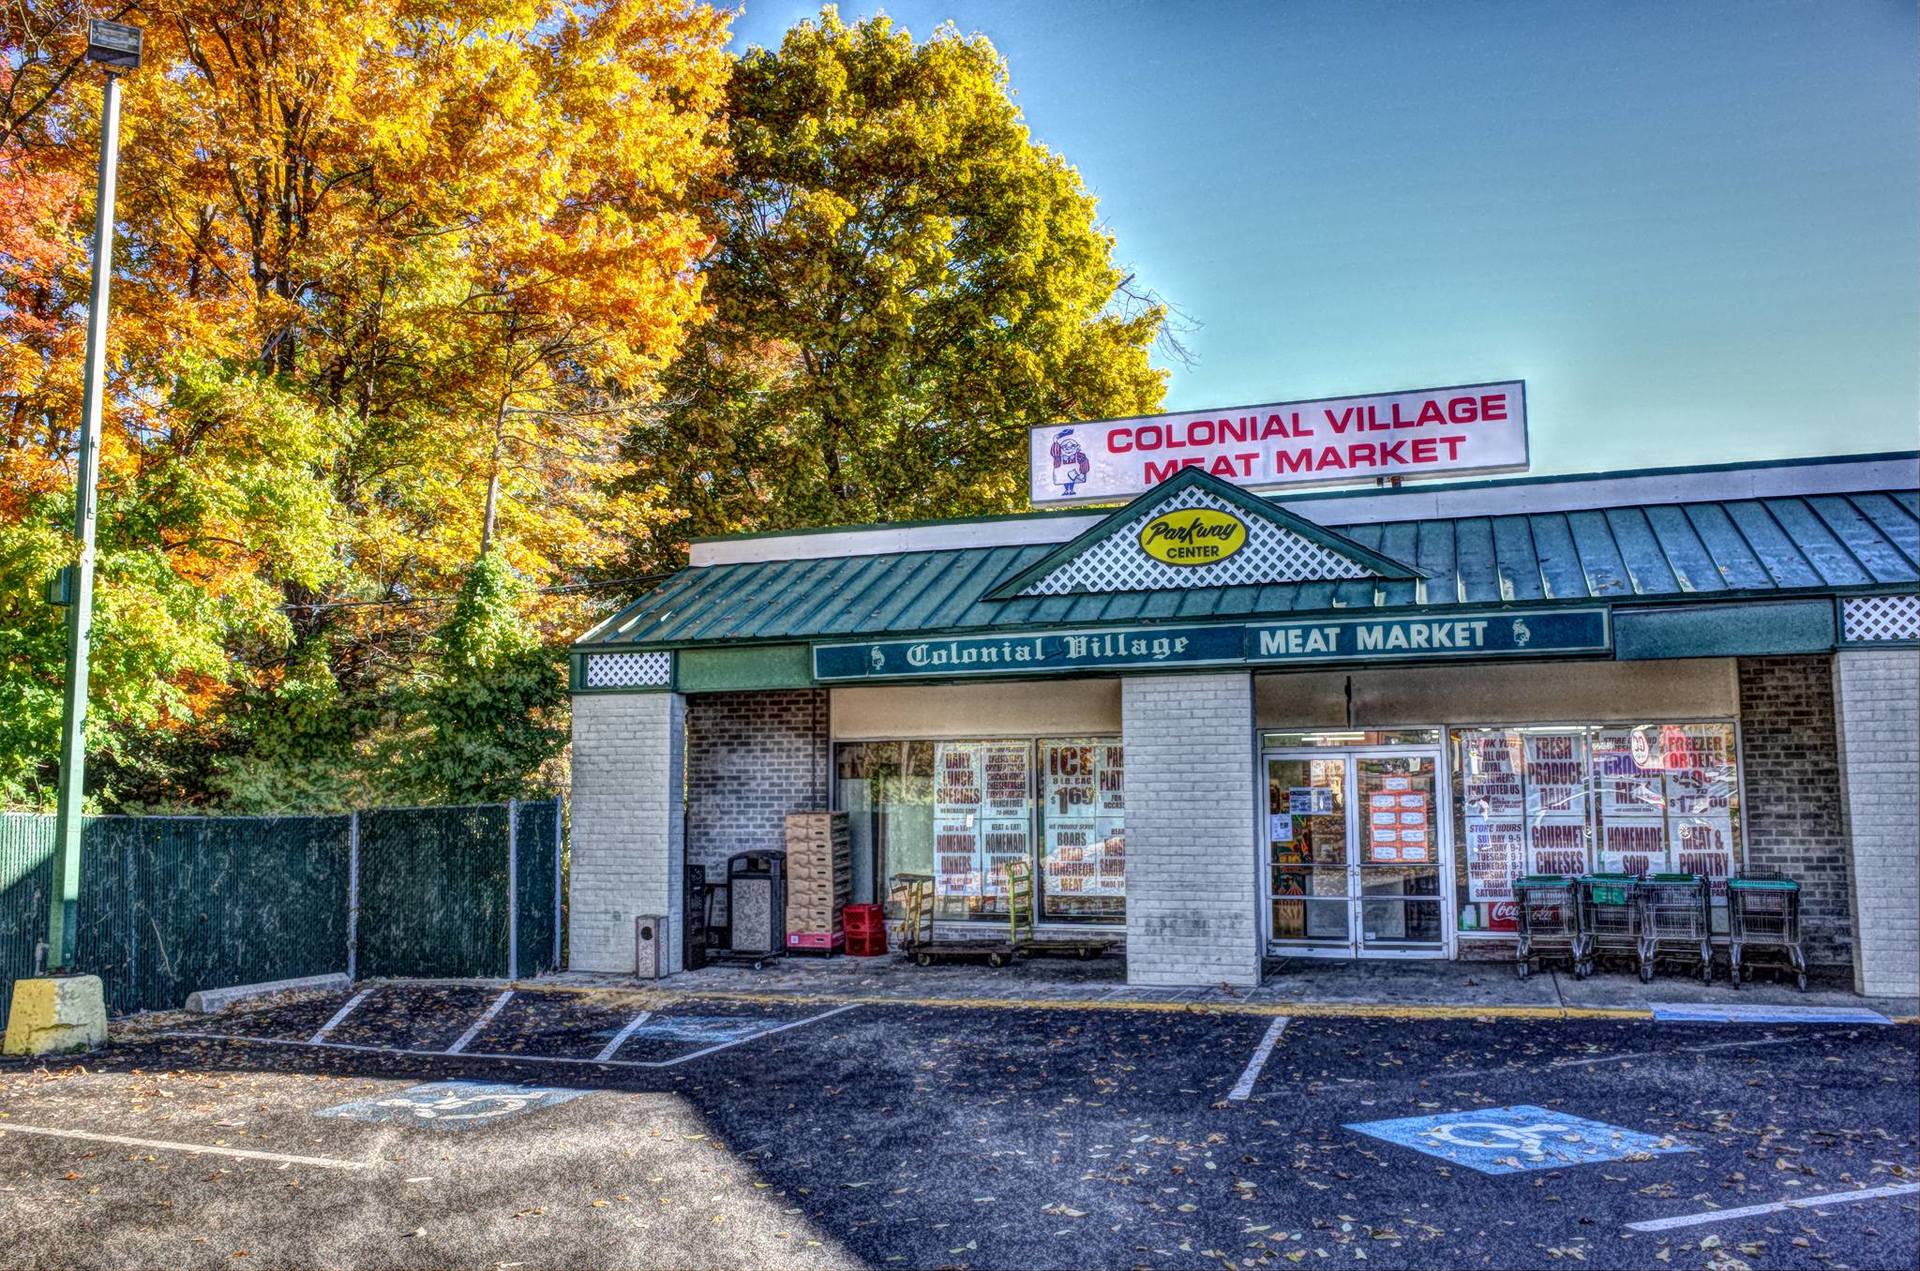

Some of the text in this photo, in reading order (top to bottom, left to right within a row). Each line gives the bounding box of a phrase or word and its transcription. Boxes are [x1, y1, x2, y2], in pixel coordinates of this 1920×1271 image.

[1107, 393, 1508, 454] COLONIAL VILLAGE
[1276, 435, 1467, 474] MARKET
[1145, 517, 1238, 545] Parkway
[1166, 545, 1220, 559] CENTER
[1259, 620, 1488, 656] MEAT MARKET
[906, 632, 1190, 667] Colonial Village
[1536, 736, 1573, 760] FRESH
[1668, 736, 1723, 752] FREEZER
[945, 752, 971, 769] DAILY
[1050, 746, 1093, 776] ICE
[1669, 752, 1721, 768] ORDERS
[942, 770, 974, 787] LUNCH
[1474, 773, 1516, 784] STOMERS
[1527, 762, 1582, 785] PRODUCE
[936, 788, 980, 804] SPECIALS
[1467, 784, 1520, 795] THAT VOTED US
[1540, 787, 1572, 811] DAILY
[1470, 823, 1522, 833] STORE HOURS
[1531, 825, 1585, 848] GOURMET
[936, 834, 976, 854] HOMEMADE
[1057, 832, 1087, 846] BOARS
[1508, 834, 1521, 842] 9-5
[1607, 826, 1663, 852] HOMEMADE
[1681, 826, 1724, 850] MEAT &
[1060, 847, 1083, 861] HEAD
[1477, 853, 1507, 861] TUESDAY
[1536, 851, 1584, 874] CHEESES
[941, 855, 972, 874] DINNERS
[1049, 862, 1095, 877] LUNCHEON
[1511, 862, 1523, 870] 9-7
[1622, 855, 1649, 878] SOUP
[1679, 852, 1729, 876] POULTRY
[1060, 878, 1083, 892] MEAT
[1484, 880, 1508, 888] FRIDAY
[1475, 889, 1512, 897] SATURDAY
